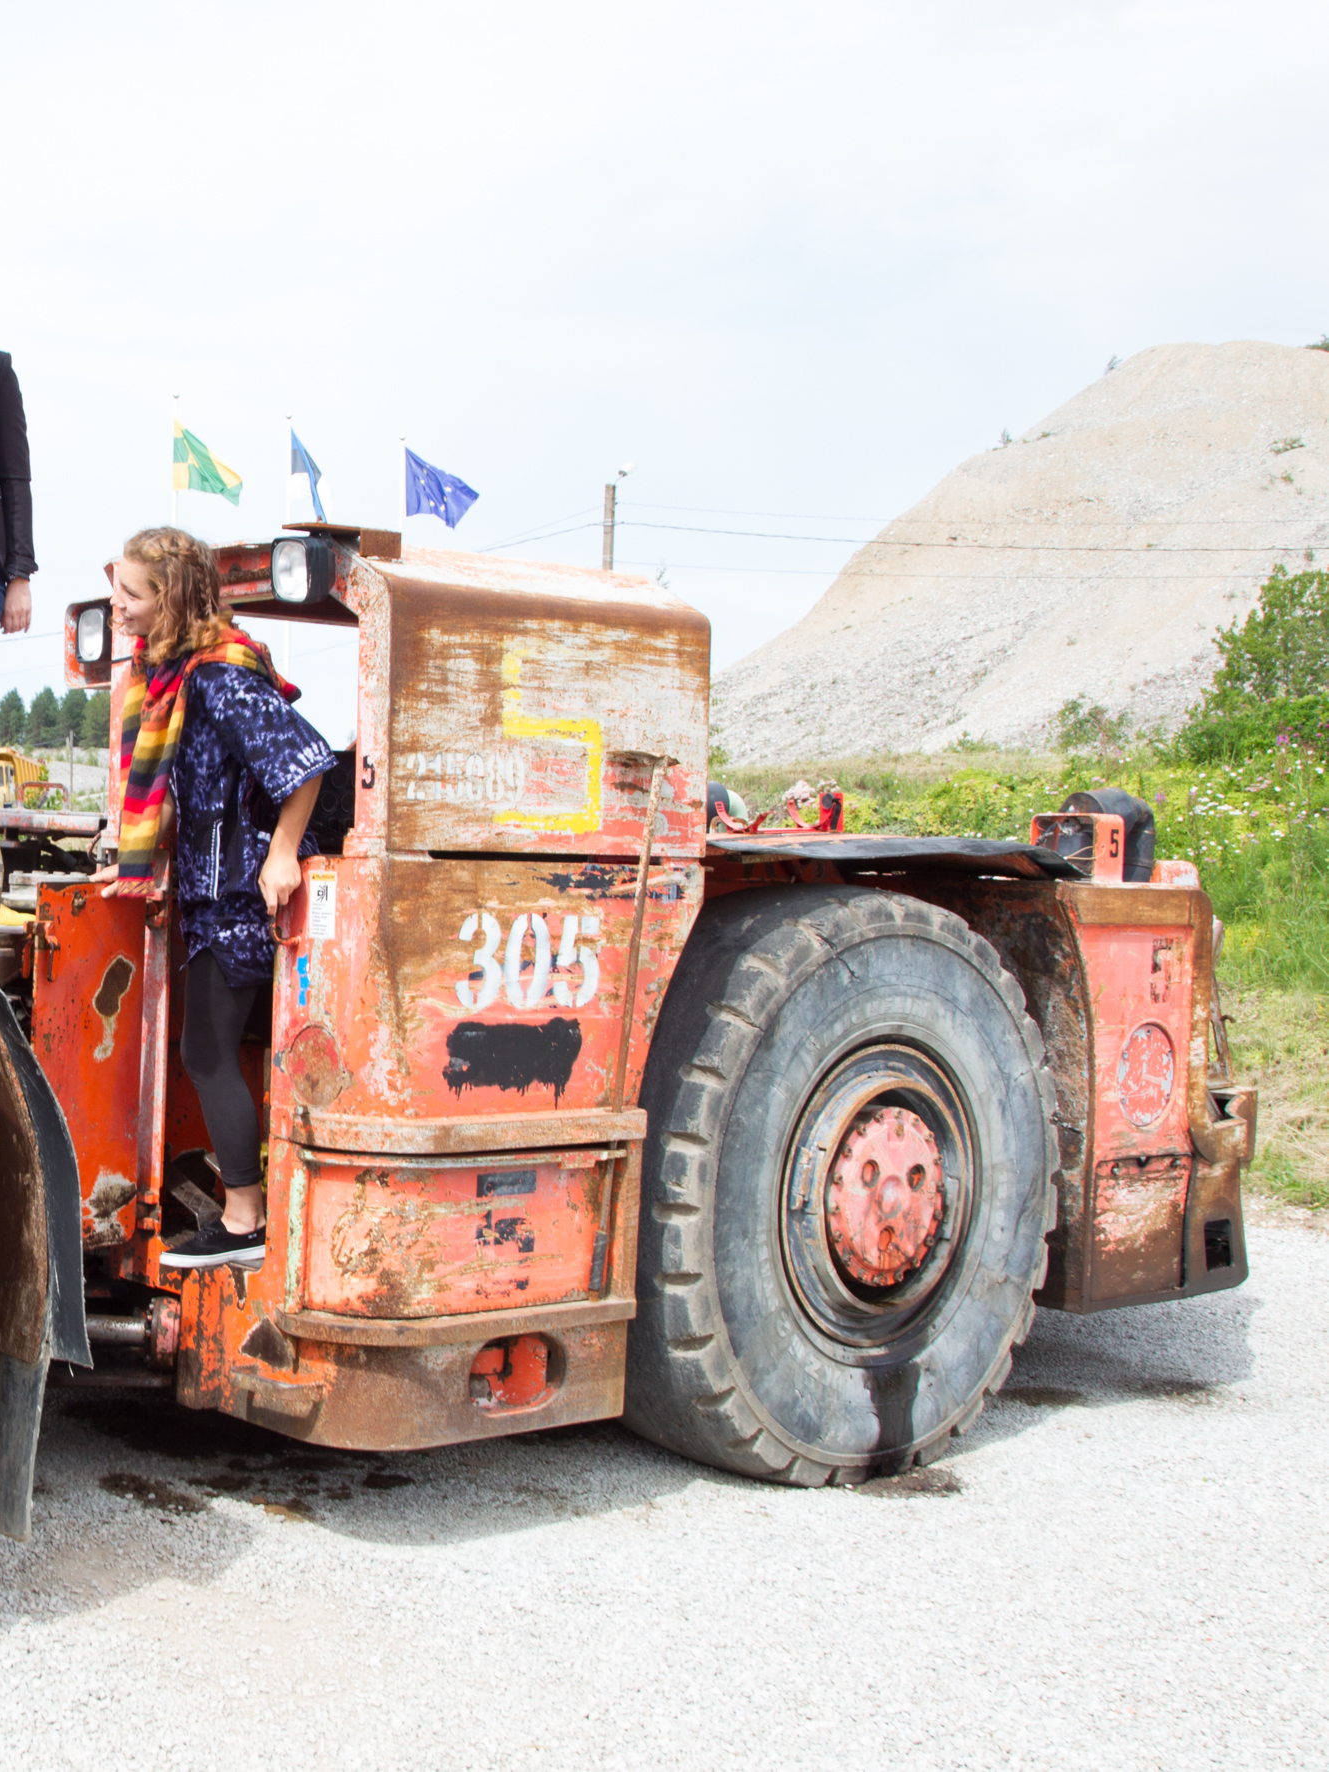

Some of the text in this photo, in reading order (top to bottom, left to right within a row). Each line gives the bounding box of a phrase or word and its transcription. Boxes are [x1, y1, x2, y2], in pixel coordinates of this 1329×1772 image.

[406, 752, 525, 804] 215089
[1110, 829, 1119, 858] 5
[455, 911, 601, 1015] 305
